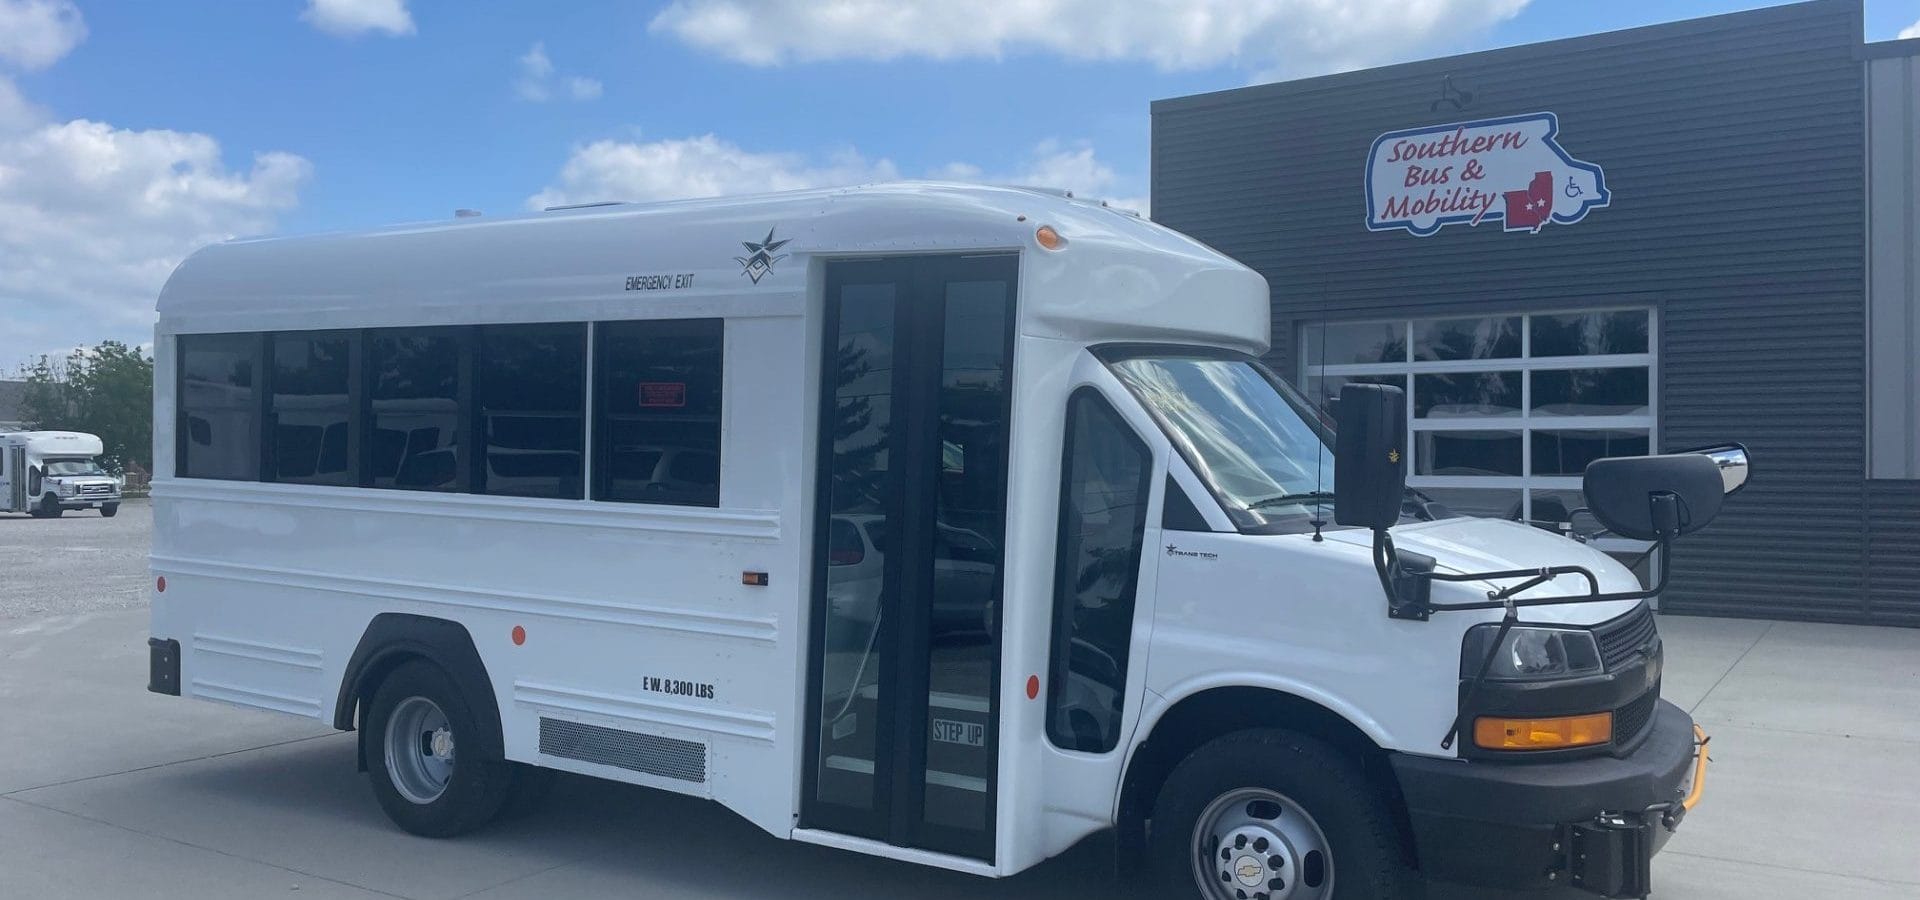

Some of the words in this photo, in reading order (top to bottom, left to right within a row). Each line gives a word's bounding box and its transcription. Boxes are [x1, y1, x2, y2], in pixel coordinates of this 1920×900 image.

[1387, 127, 1528, 162] Southern
[1404, 164, 1453, 187] Bus
[1460, 159, 1486, 181] &
[1381, 187, 1496, 225] Mobility
[625, 275, 673, 291] EMERGENCY
[675, 273, 694, 289] EXIT
[664, 679, 693, 696] 8,300
[696, 683, 714, 699] LBS
[934, 720, 963, 742] STEP
[968, 724, 982, 744] UP
